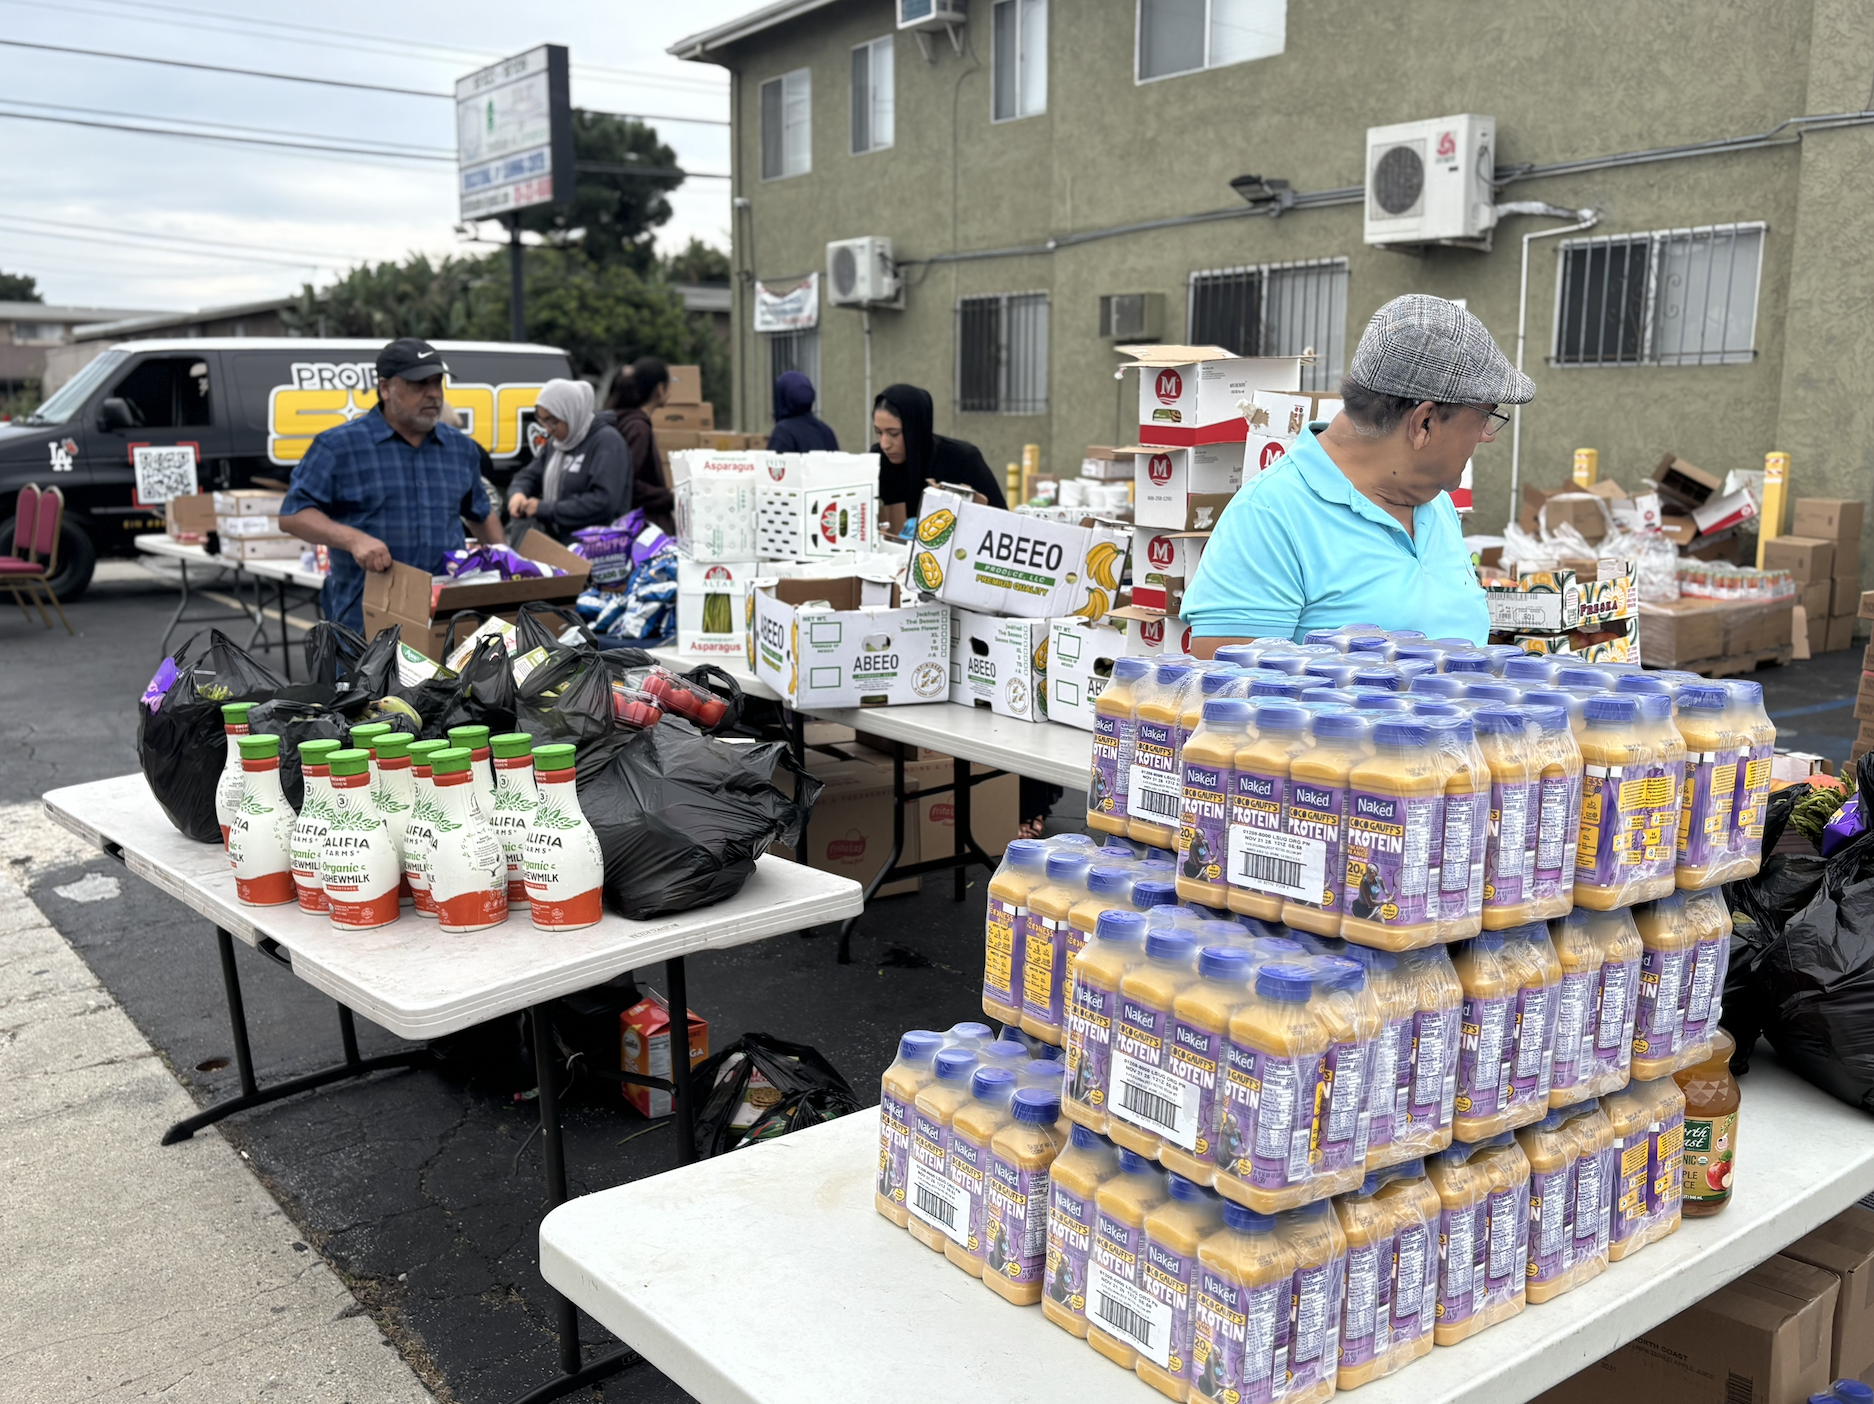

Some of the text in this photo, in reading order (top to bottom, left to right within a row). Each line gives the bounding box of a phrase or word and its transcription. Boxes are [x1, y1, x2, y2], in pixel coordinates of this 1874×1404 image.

[1160, 376, 1177, 396] M
[704, 461, 755, 473] Asparagus
[1153, 459, 1168, 477] M
[976, 529, 1063, 571] ABEEO
[1153, 542, 1168, 562] M
[984, 565, 1046, 583] PRODUCE, LLC
[975, 573, 1049, 597] PREMIUM QUALITY
[690, 642, 742, 653] Asparagus
[853, 654, 899, 672] ABEEO
[968, 657, 996, 678] ABEEO
[1096, 720, 1114, 733] aked
[1141, 727, 1167, 742] Naked
[1135, 750, 1173, 770] PROTEIN
[1187, 769, 1217, 786] Naked
[1240, 778, 1271, 795] Naked
[1182, 787, 1223, 802] COCO GAUFF'S
[1234, 796, 1278, 812] COCO GAUFF'S
[1296, 789, 1330, 807] Naked
[1181, 797, 1224, 819] PROTEIN
[1233, 806, 1279, 829] PROTEIN
[1290, 808, 1337, 824] COCO GAUFF'S
[1357, 799, 1394, 817] Naked
[1288, 818, 1338, 842] PROTEIN
[1350, 818, 1401, 835] COCO GAUFF'S
[1348, 829, 1403, 853] PROTEIN
[1076, 987, 1104, 1008] Naked
[1085, 1009, 1109, 1026] GAUFF'S
[1124, 1005, 1154, 1028] Naked
[1070, 1015, 1109, 1044] PROTEIN
[1134, 1028, 1159, 1046] GAUFF'S
[1177, 1027, 1208, 1050] Naked
[1117, 1033, 1160, 1065] PROTEIN
[1171, 1046, 1214, 1069] COCO GAUFF'S
[1228, 1050, 1254, 1070] aked
[1169, 1056, 1215, 1089] PROTEIN
[1232, 1072, 1259, 1089] GAUFF'S
[884, 1097, 904, 1119] Naked
[917, 1119, 939, 1141] Naked
[954, 1140, 977, 1163] Naked
[994, 1162, 1019, 1186] Naked
[989, 1187, 1025, 1220] PROTEIN
[1003, 1184, 1024, 1204] GAUFF'S
[1055, 1191, 1081, 1216] Naked
[1049, 1217, 1089, 1251] PROTEIN
[1064, 1215, 1088, 1235] GAUFF'S
[1100, 1219, 1127, 1244] Naked
[1094, 1244, 1135, 1280] PROTEIN
[1109, 1243, 1134, 1262] GAUFF'S
[1150, 1246, 1179, 1274] Naked
[1143, 1273, 1187, 1310] PROTEIN
[1159, 1271, 1186, 1294] GAUFF'S
[1204, 1275, 1236, 1304] Naked
[1198, 1292, 1244, 1324] COCO GAUFF'S
[1196, 1303, 1245, 1343] PROTEIN
[1661, 1346, 1688, 1361] COAST
